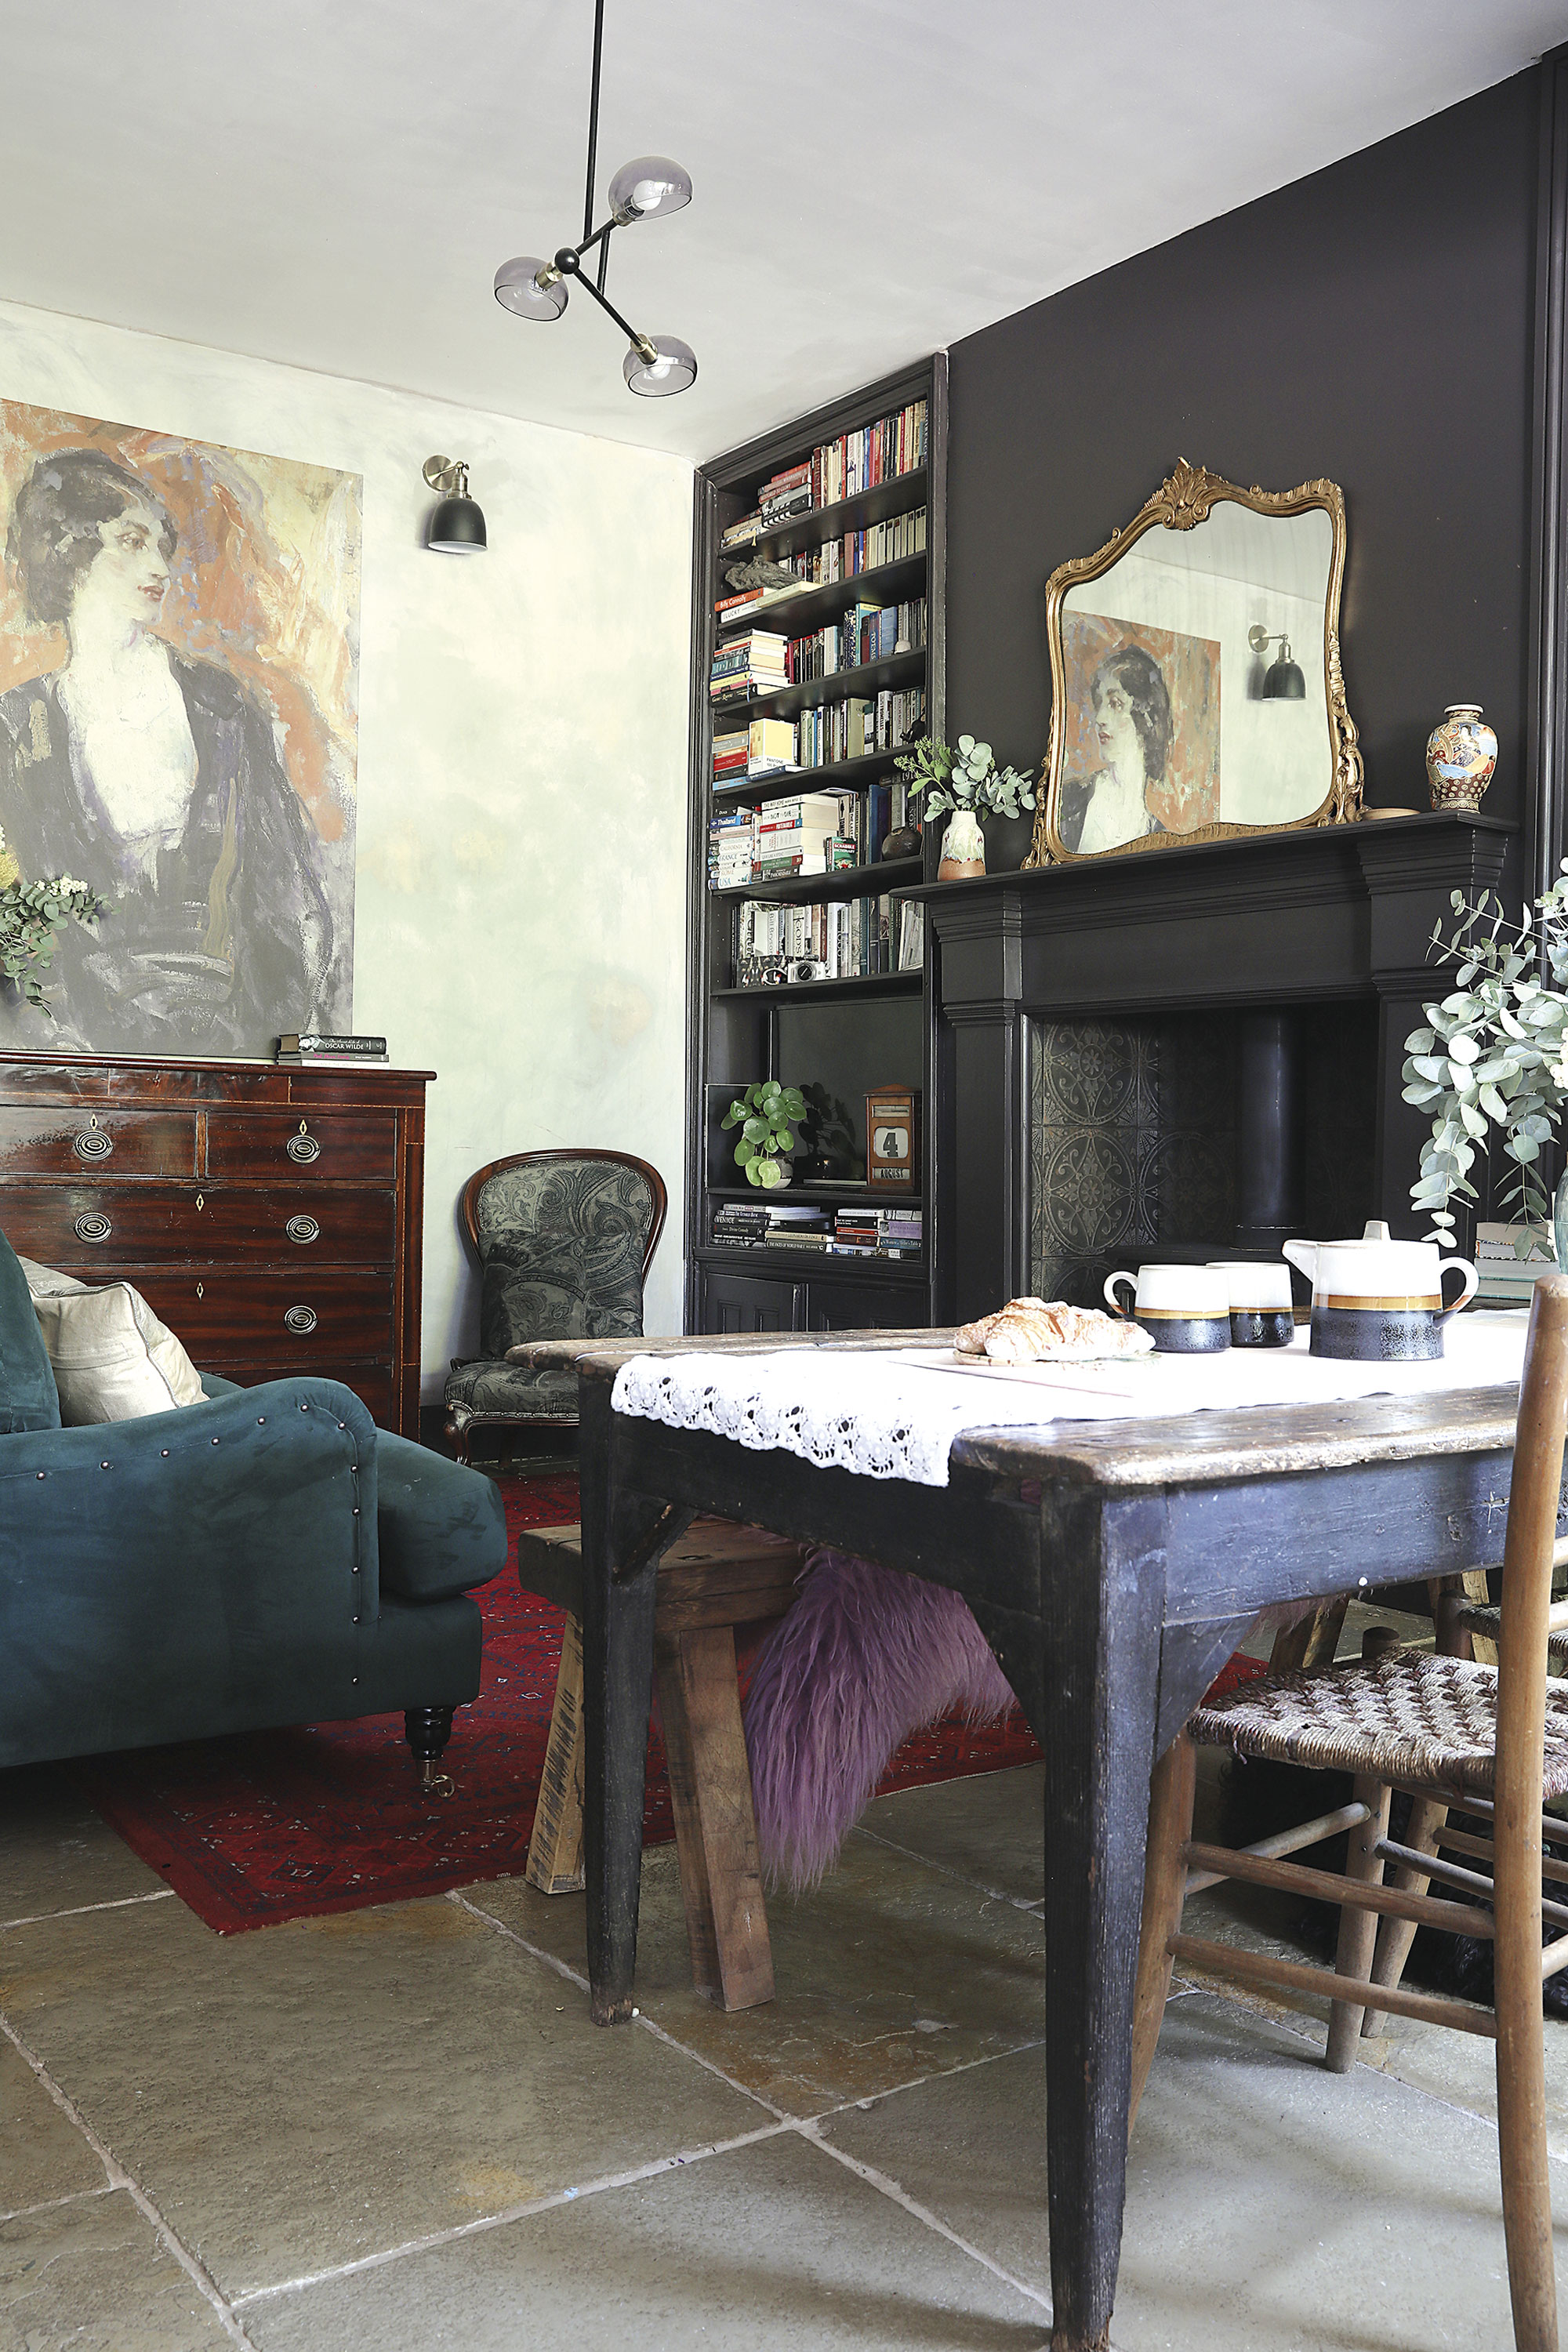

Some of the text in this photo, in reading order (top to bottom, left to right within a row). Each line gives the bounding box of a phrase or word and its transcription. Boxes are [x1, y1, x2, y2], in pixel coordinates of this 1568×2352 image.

[720, 594, 746, 609] Billy Connolly
[717, 817, 736, 826] Thailand
[719, 853, 737, 862] FRANCE
[719, 877, 731, 887] USA
[883, 1132, 898, 1157] 4
[880, 1168, 903, 1179] AUGUST
